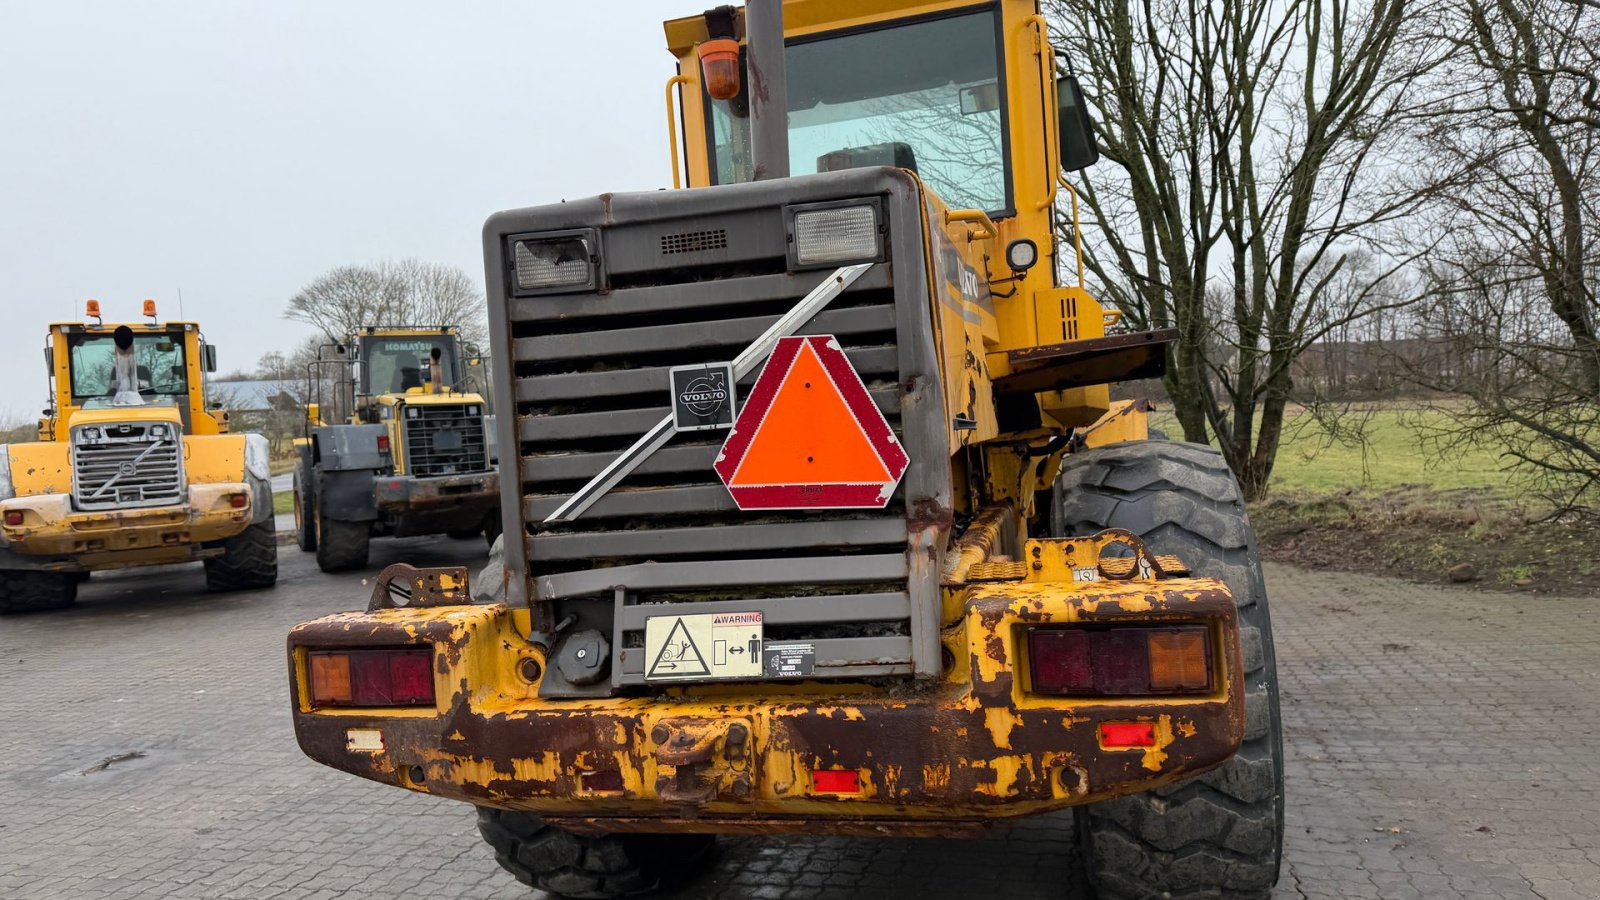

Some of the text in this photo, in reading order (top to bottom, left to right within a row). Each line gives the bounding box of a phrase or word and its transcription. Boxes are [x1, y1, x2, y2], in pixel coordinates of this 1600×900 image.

[385, 342, 432, 351] KOMATSU
[683, 391, 724, 401] VOLVO
[721, 614, 762, 623] WARNING
